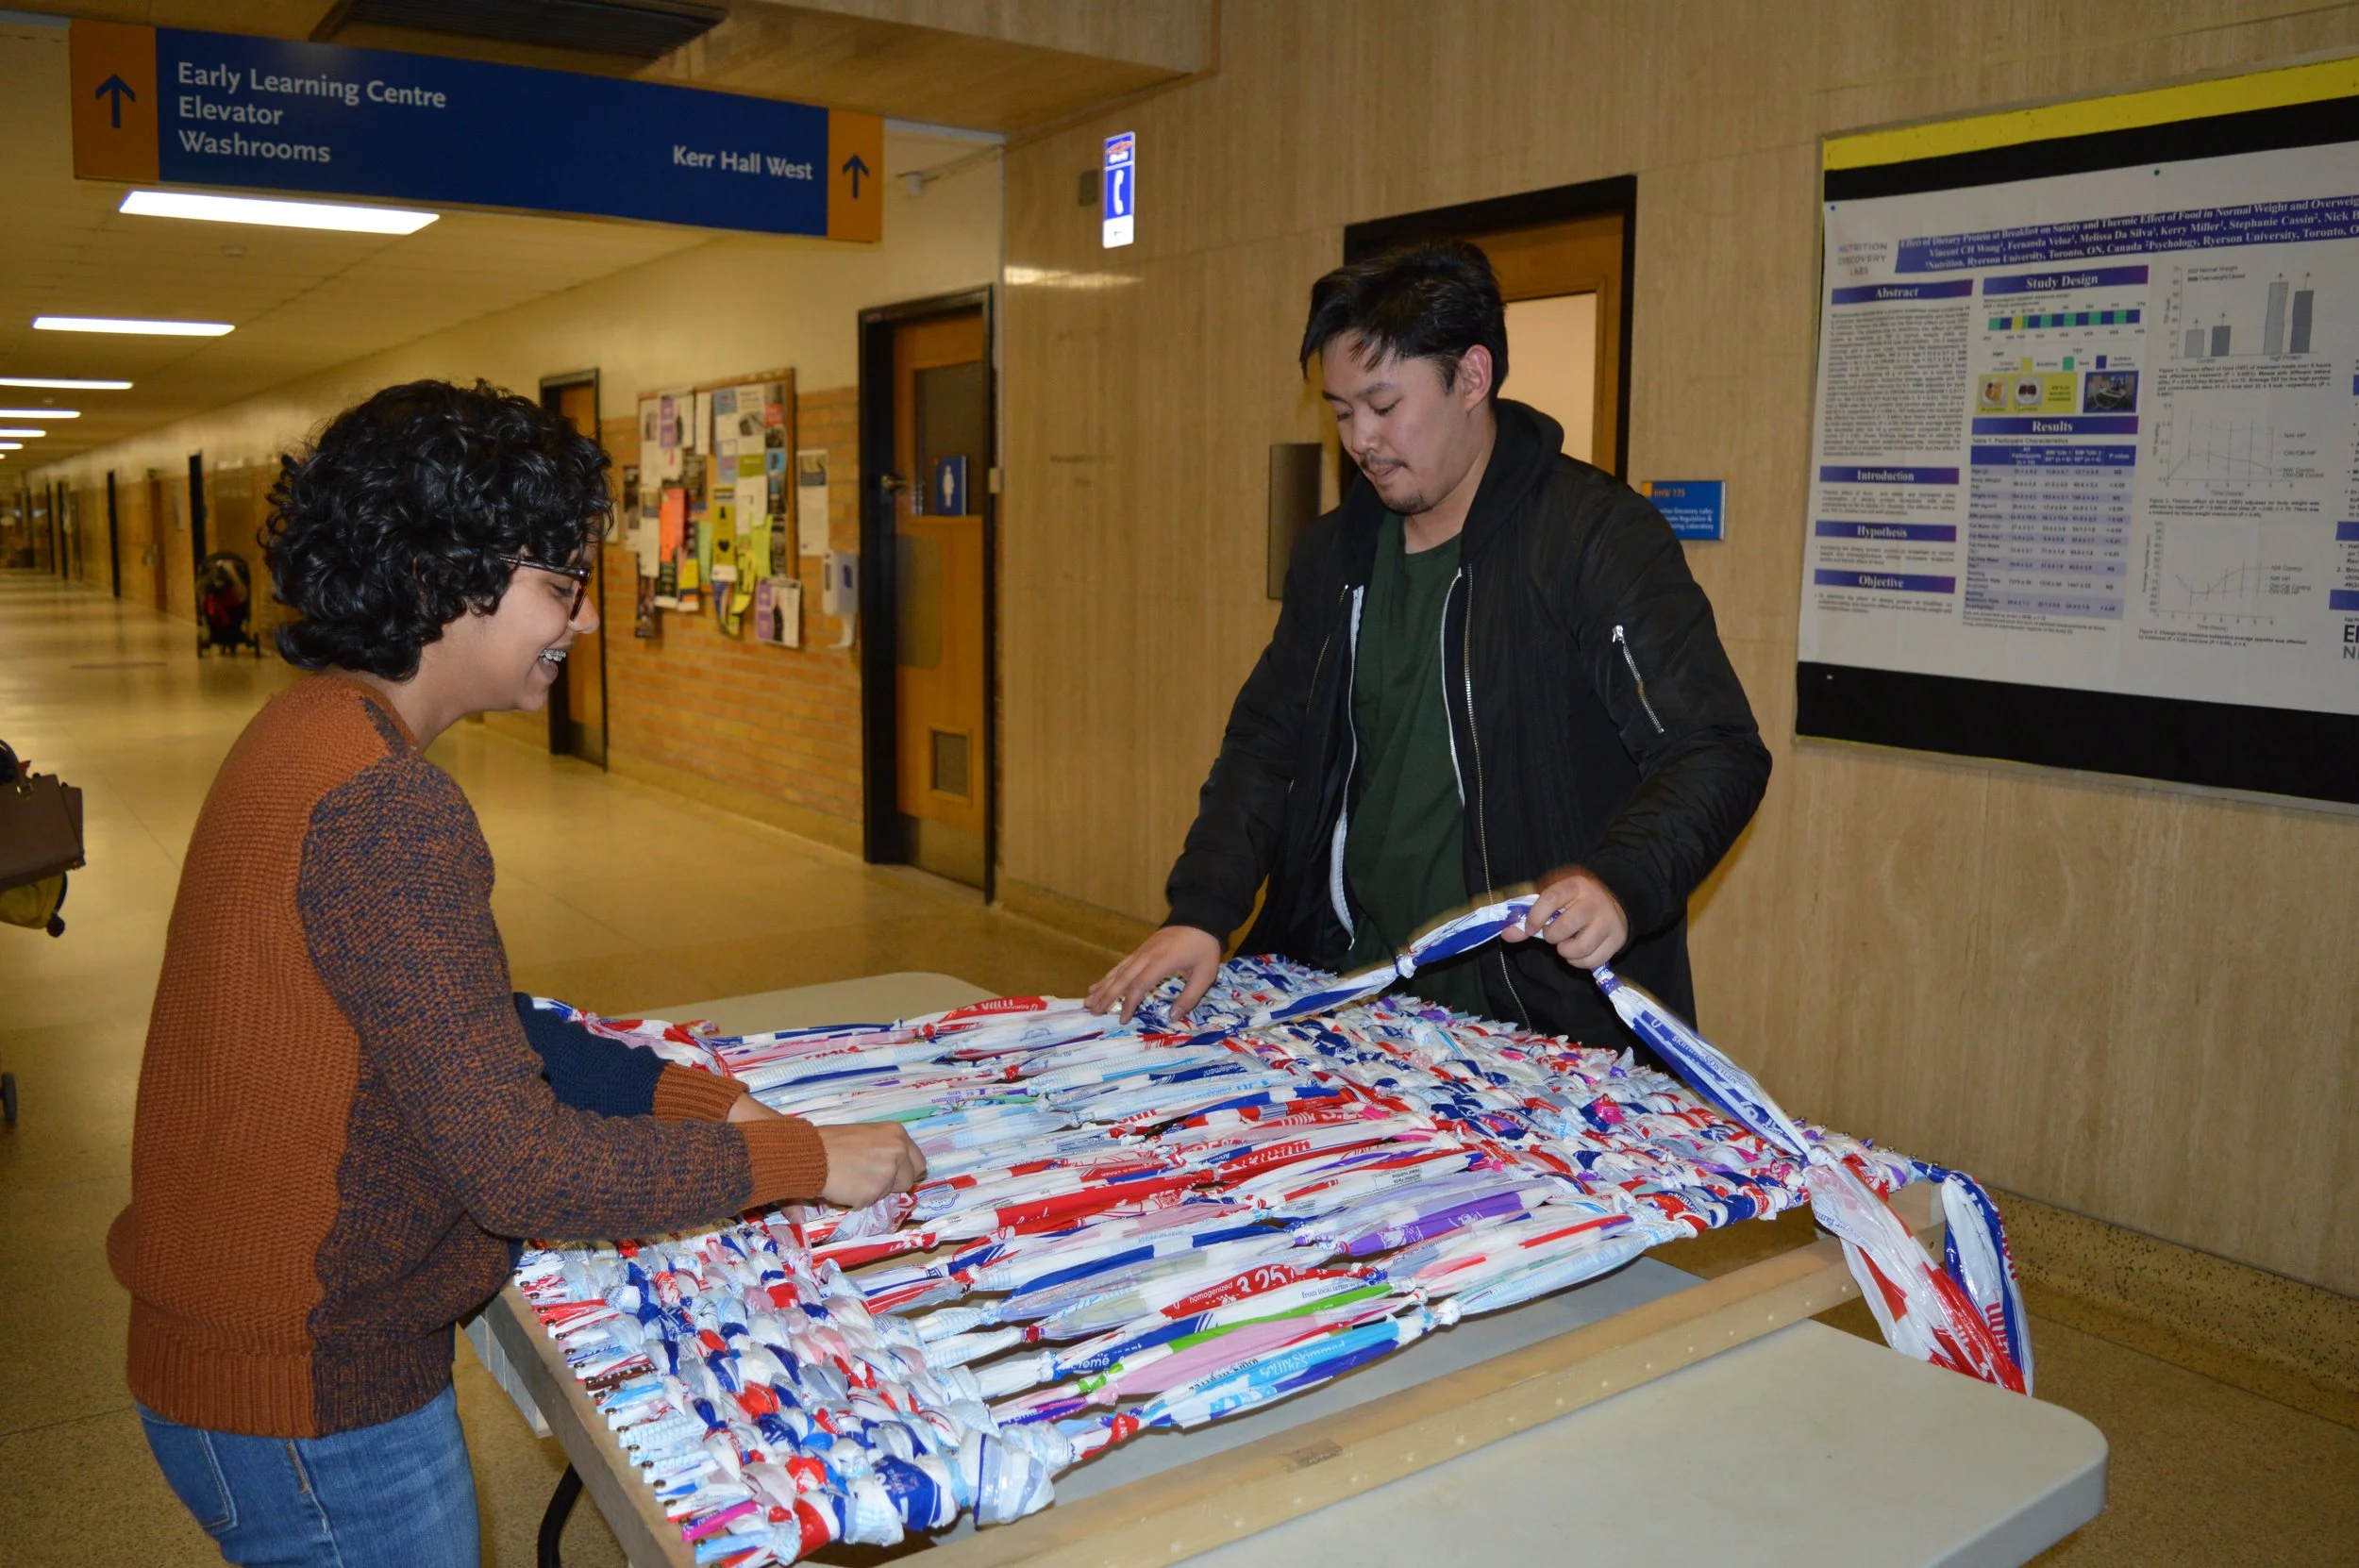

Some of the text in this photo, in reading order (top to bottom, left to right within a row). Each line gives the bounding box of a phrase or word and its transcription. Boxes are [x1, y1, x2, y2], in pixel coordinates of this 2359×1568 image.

[177, 60, 447, 109] Early Learning Centre
[177, 94, 284, 125] Elevator
[177, 128, 331, 163] Washrooms
[672, 143, 814, 181] Kerr Hall West
[1929, 245, 1960, 259] Vincent
[1961, 243, 1976, 255] CH
[2008, 238, 2047, 251] Fernanda
[2080, 231, 2113, 245] Melissa
[2114, 229, 2128, 241] Da
[2161, 224, 2187, 237] Kerry
[2229, 217, 2279, 232] Stephanie
[2324, 210, 2349, 223] Nick
[1933, 233, 1961, 247] Dietary
[1963, 231, 1991, 245] Protein
[1992, 230, 2001, 241] at
[2002, 227, 2038, 241] Breakfast
[2040, 225, 2051, 235] on
[2052, 221, 2081, 235] Satiety
[2083, 218, 2100, 230] and
[2101, 213, 2138, 228] Thermic
[2140, 211, 2167, 225] Effect
[2167, 210, 2179, 223] of
[2179, 209, 2201, 221] Food
[2203, 208, 2214, 219] in
[2215, 205, 2252, 218] Normal
[2254, 201, 2288, 215] Weight
[2289, 199, 2309, 211] and
[1839, 242, 1887, 254] NUTRITION
[1967, 255, 2001, 268] Ryerson
[2107, 242, 2143, 255] Canada
[2202, 232, 2243, 247] Ryerson
[1875, 287, 1919, 298] Abstract
[2026, 274, 2099, 291] Study Design
[2032, 420, 2074, 434] Results
[1856, 469, 1916, 482] Introduction
[1856, 525, 1908, 540] Hypothesis
[1858, 575, 1905, 589] Objective
[1188, 1281, 1234, 1304] homogenized
